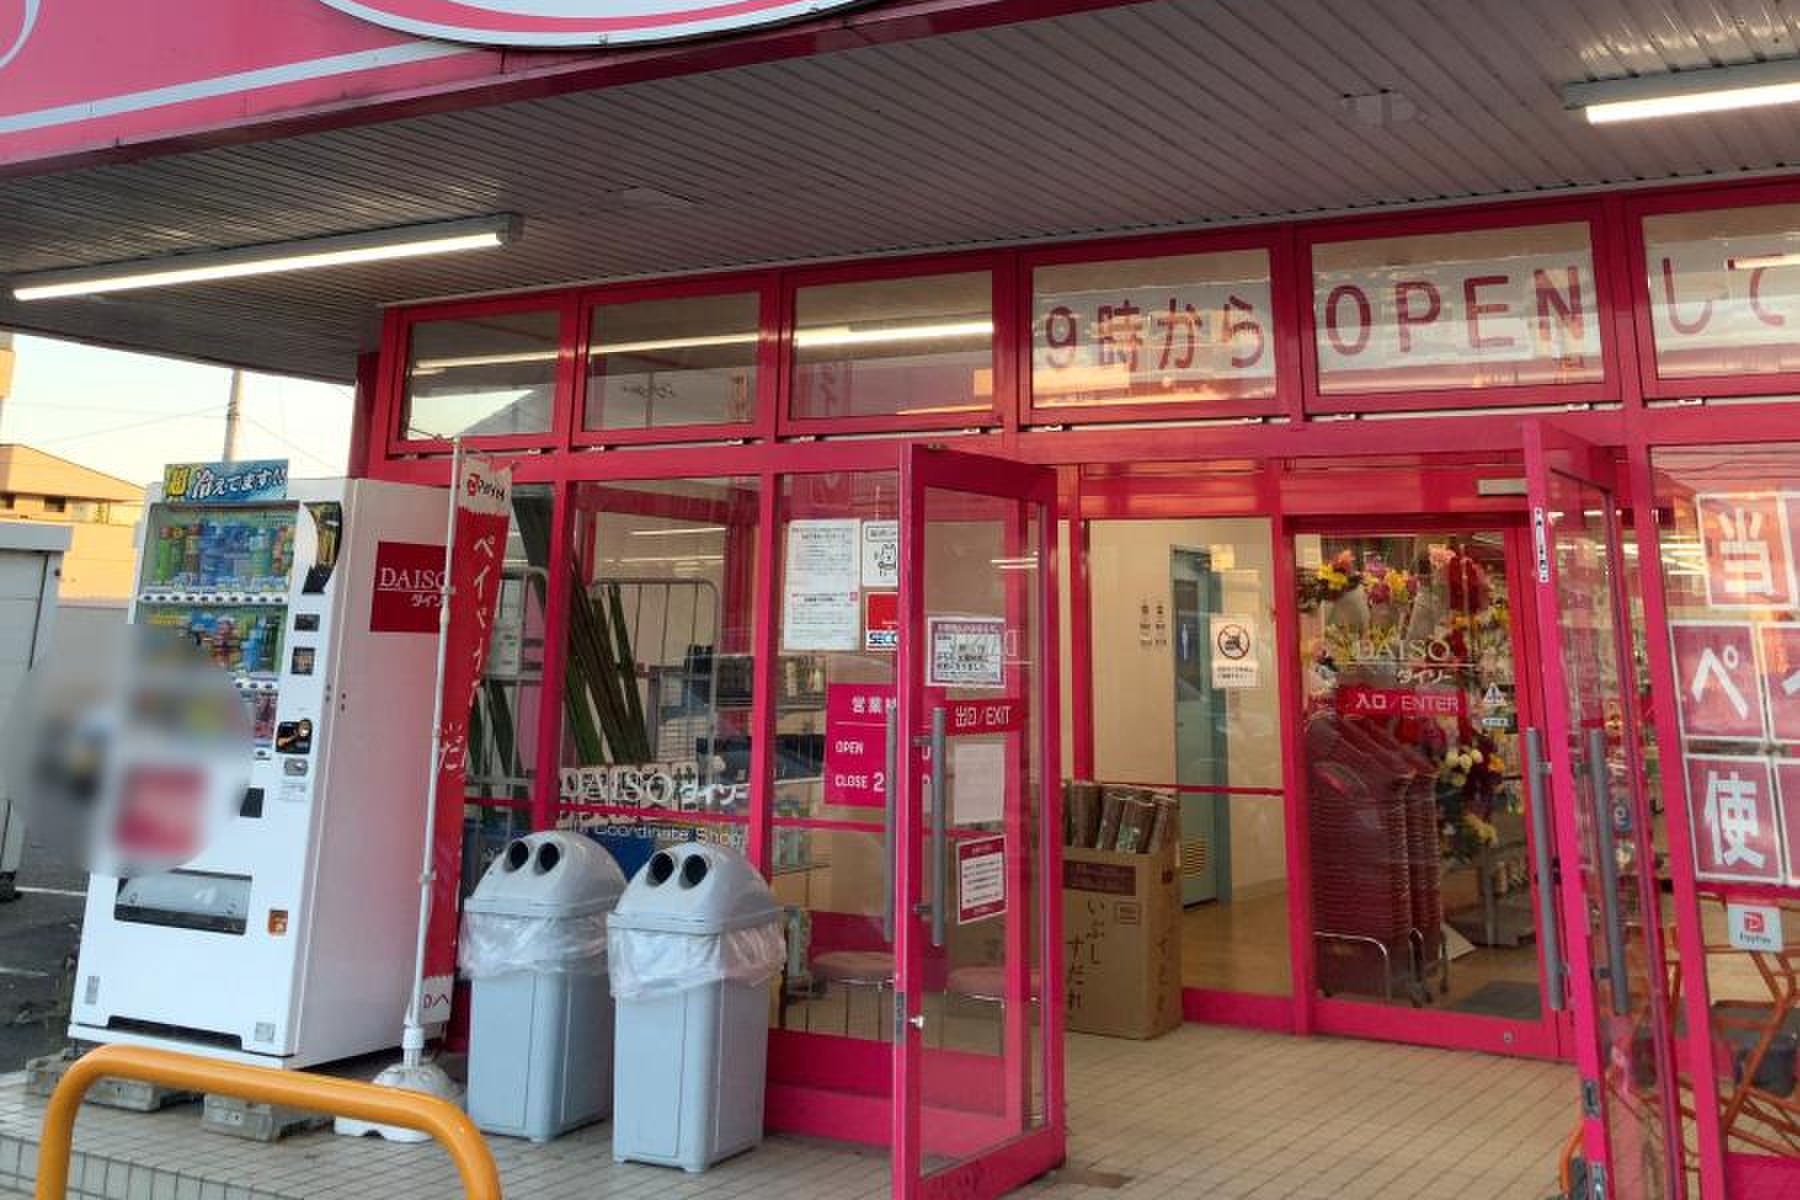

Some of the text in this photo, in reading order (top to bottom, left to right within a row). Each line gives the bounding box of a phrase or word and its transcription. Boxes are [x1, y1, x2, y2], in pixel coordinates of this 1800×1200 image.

[1046, 295, 1265, 371] 9時から
[1326, 266, 1585, 355] OPEN
[1719, 506, 1773, 594] 当
[1354, 638, 1452, 661] DAISO
[1398, 669, 1453, 685] ダイソー
[1401, 695, 1459, 712] ENTER
[835, 741, 865, 755] OPEN
[835, 774, 868, 790] CLOSE
[1704, 771, 1766, 868] 使
